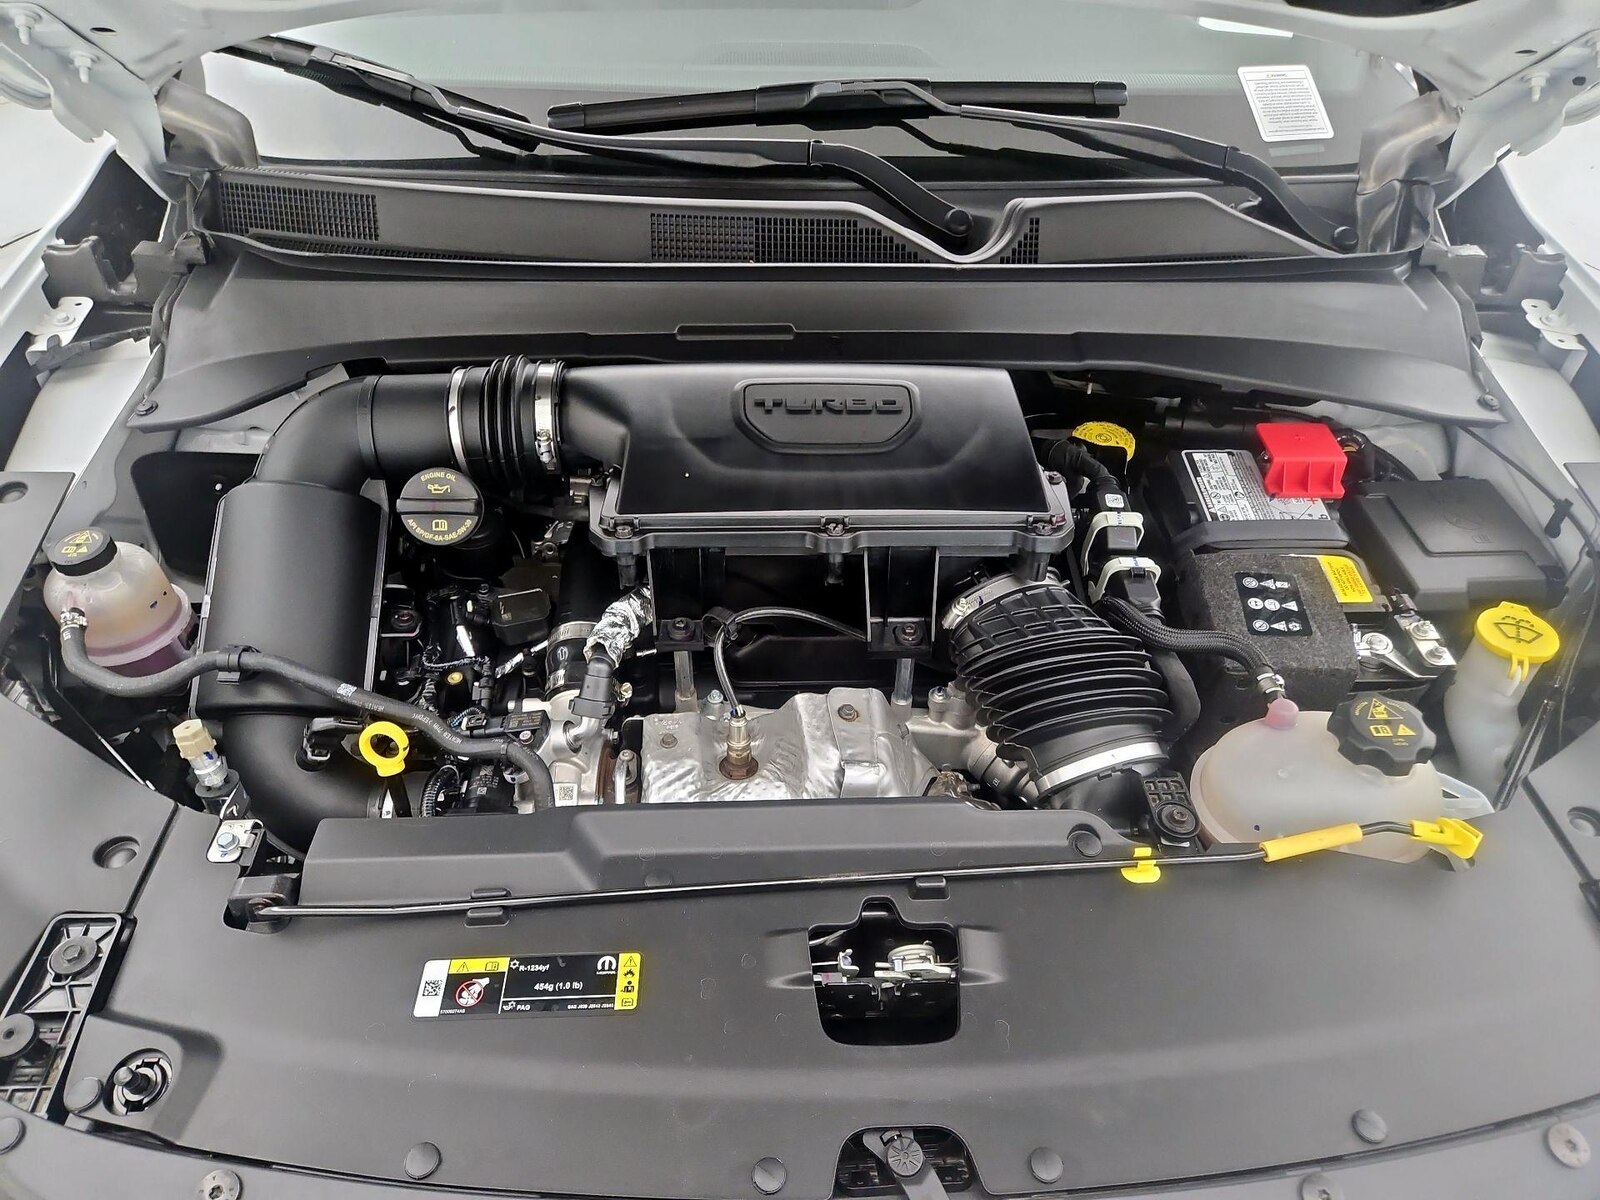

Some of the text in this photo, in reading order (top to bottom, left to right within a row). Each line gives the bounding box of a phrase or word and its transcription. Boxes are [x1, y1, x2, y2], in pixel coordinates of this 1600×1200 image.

[754, 397, 904, 415] TURBO
[420, 471, 456, 482] ENGINE OIL
[407, 519, 417, 530] API
[519, 964, 550, 972] R-1234yf
[533, 981, 584, 992] 454g (1.0 lb)
